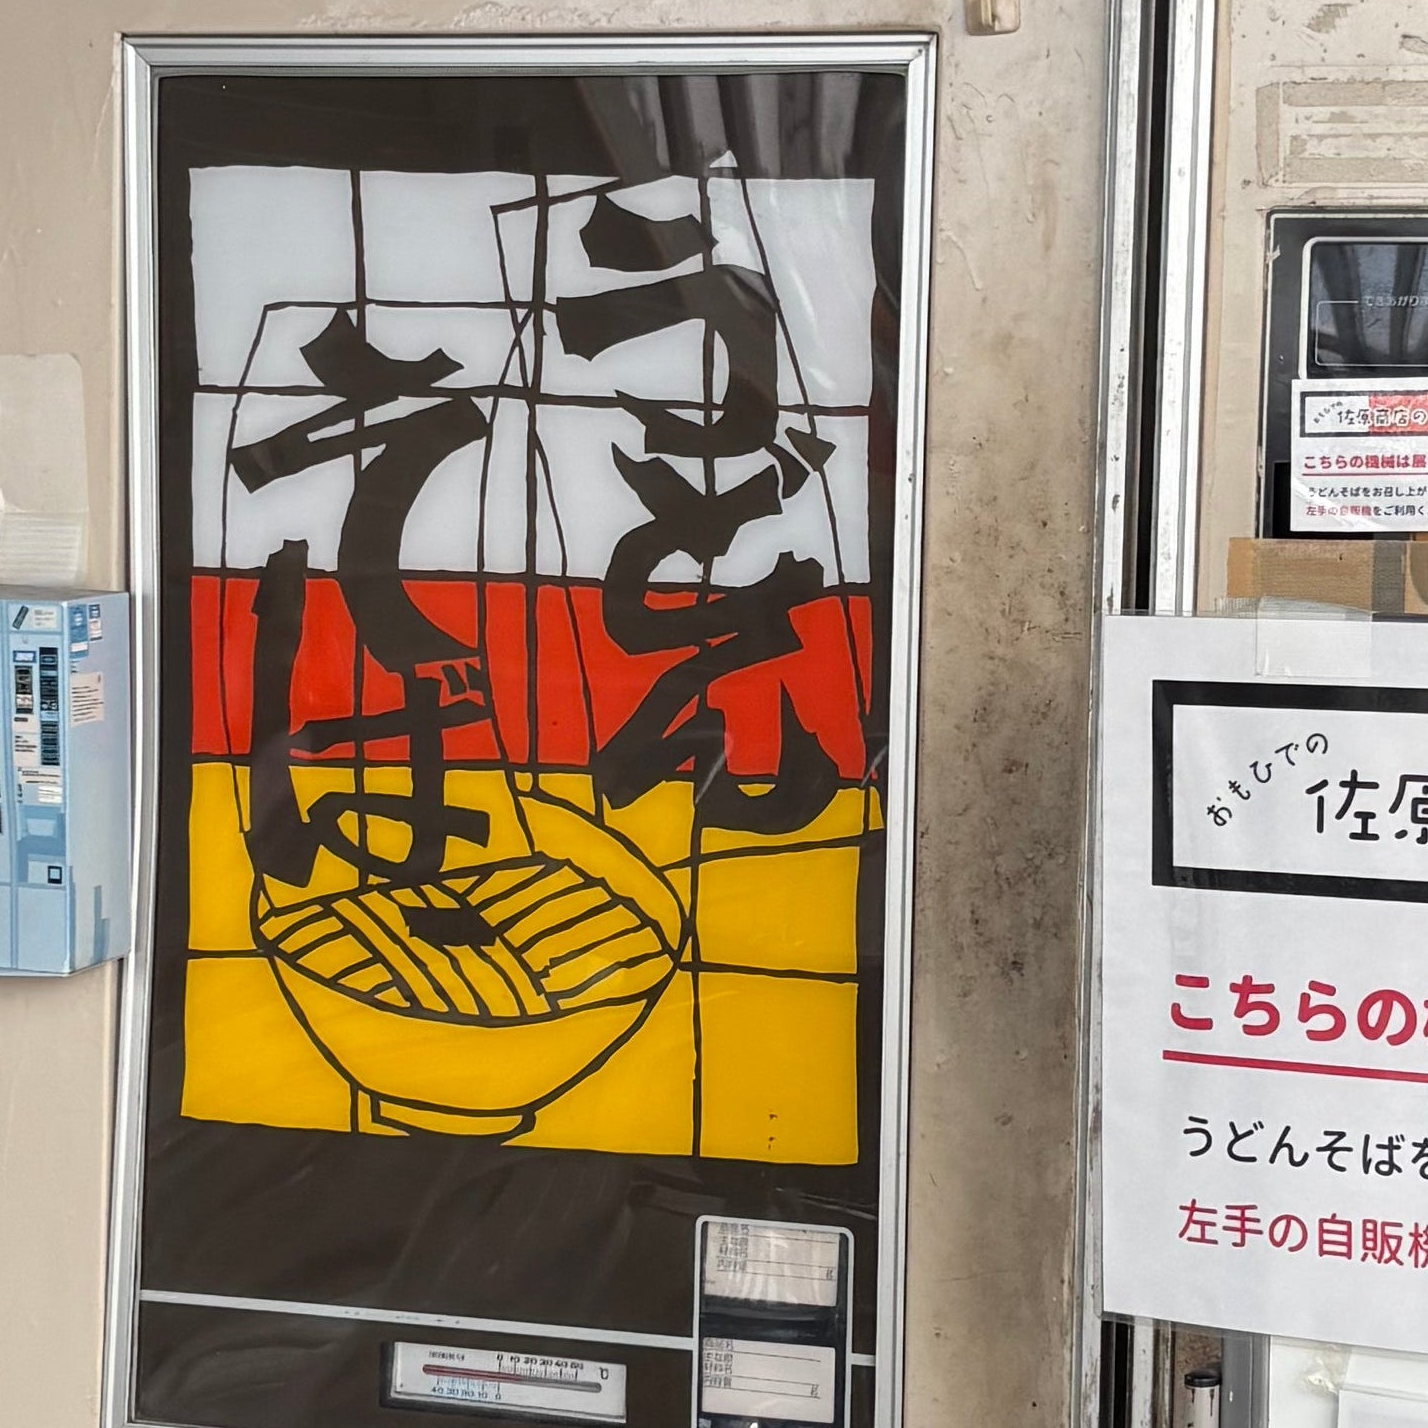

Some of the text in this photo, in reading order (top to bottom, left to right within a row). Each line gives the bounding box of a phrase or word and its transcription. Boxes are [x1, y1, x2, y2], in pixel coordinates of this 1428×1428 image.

[1206, 729, 1331, 829] おもひでの
